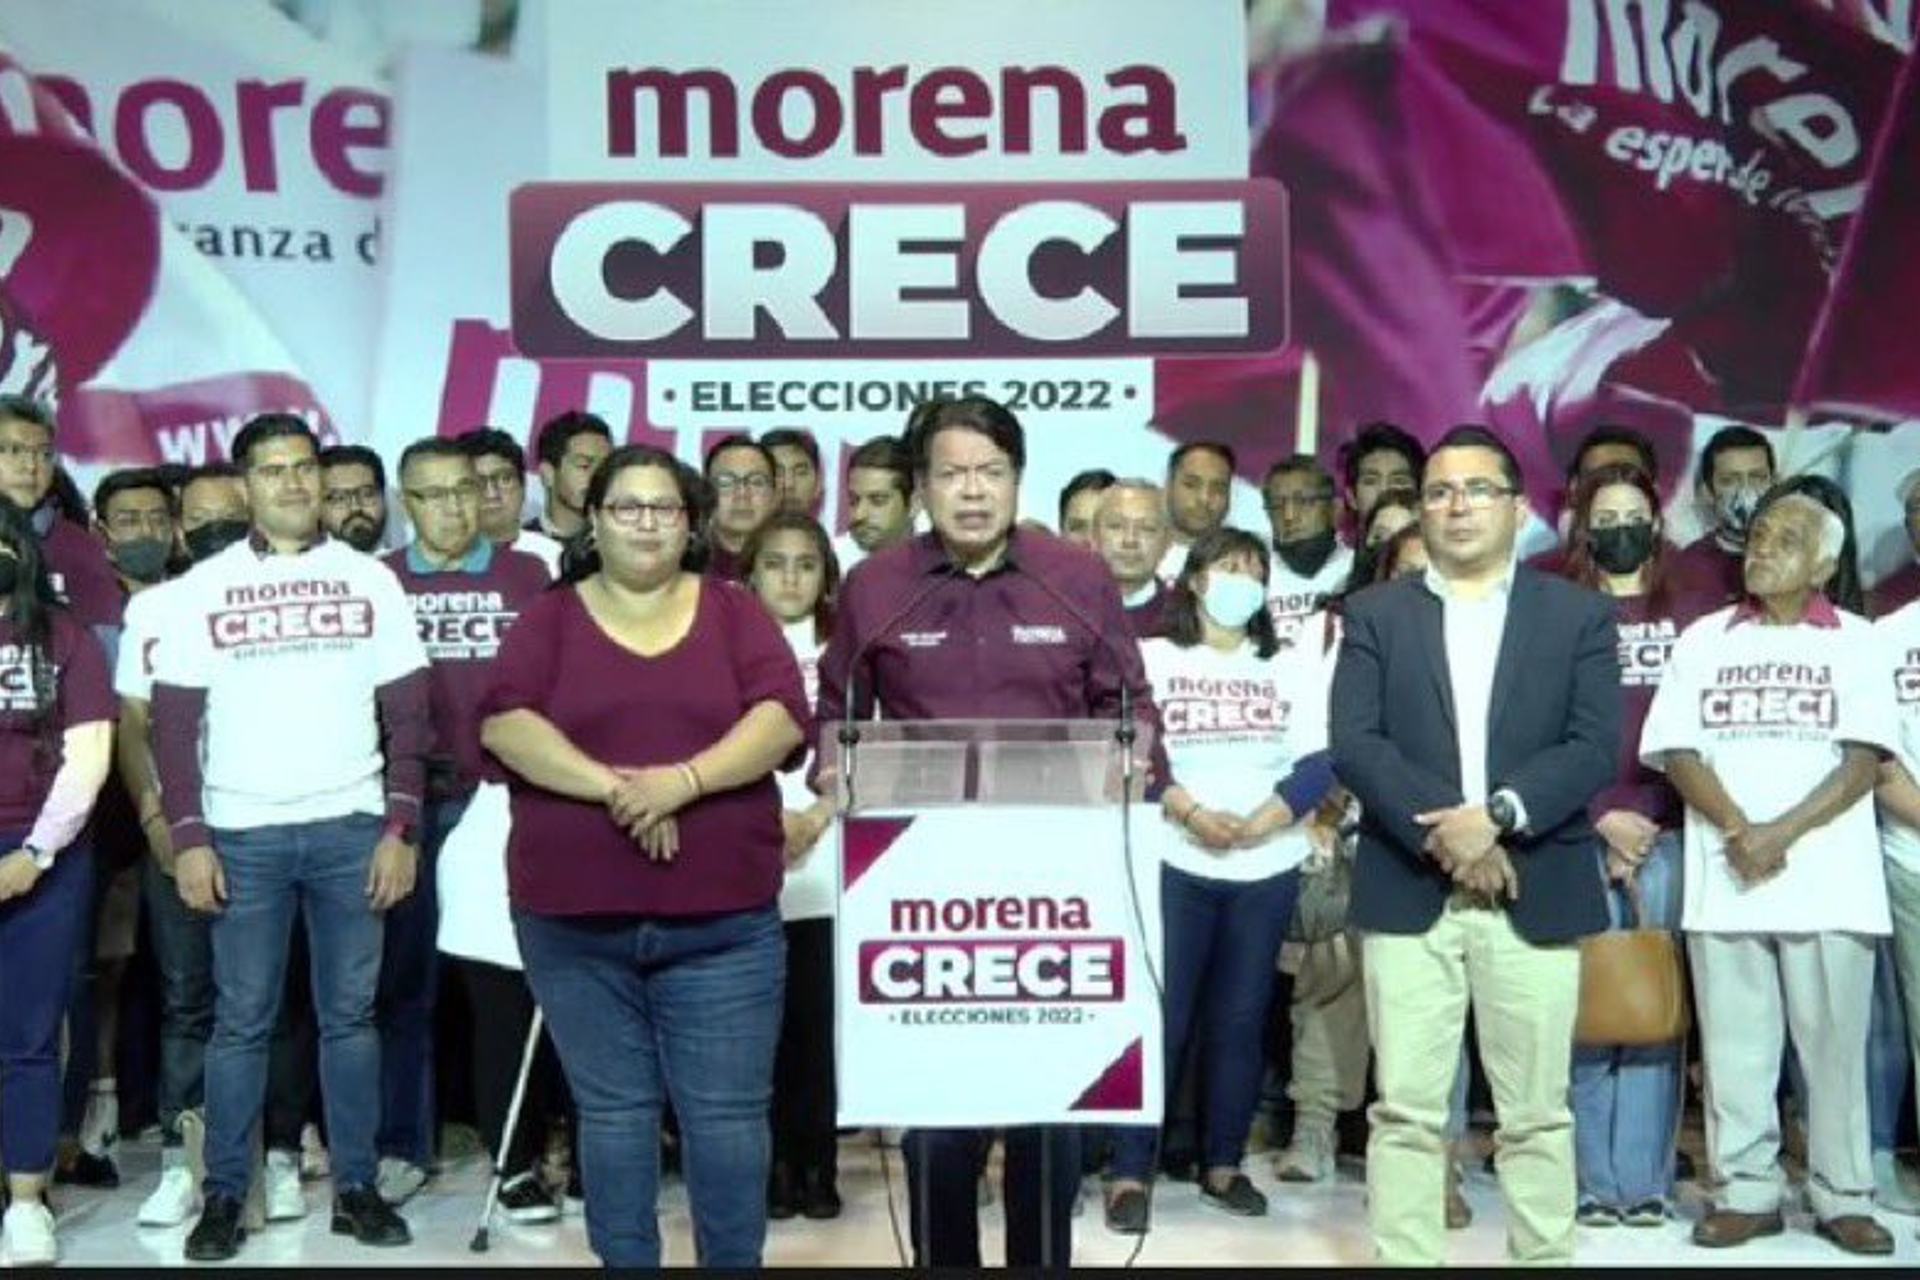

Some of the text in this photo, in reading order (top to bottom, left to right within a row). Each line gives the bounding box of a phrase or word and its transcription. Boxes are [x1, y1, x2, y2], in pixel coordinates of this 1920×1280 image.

[606, 64, 1187, 158] morena
[177, 222, 333, 262] anza
[550, 200, 1250, 341] CRECE
[691, 380, 1112, 412] ELECCIONES 2022
[226, 579, 350, 605] morena
[213, 602, 368, 645] CRECE
[1169, 676, 1277, 699] morena
[1716, 663, 1832, 686] morena
[890, 897, 1091, 932] morena
[871, 943, 1114, 998] CRECE
[900, 1007, 1031, 1025] ELECCIONES
